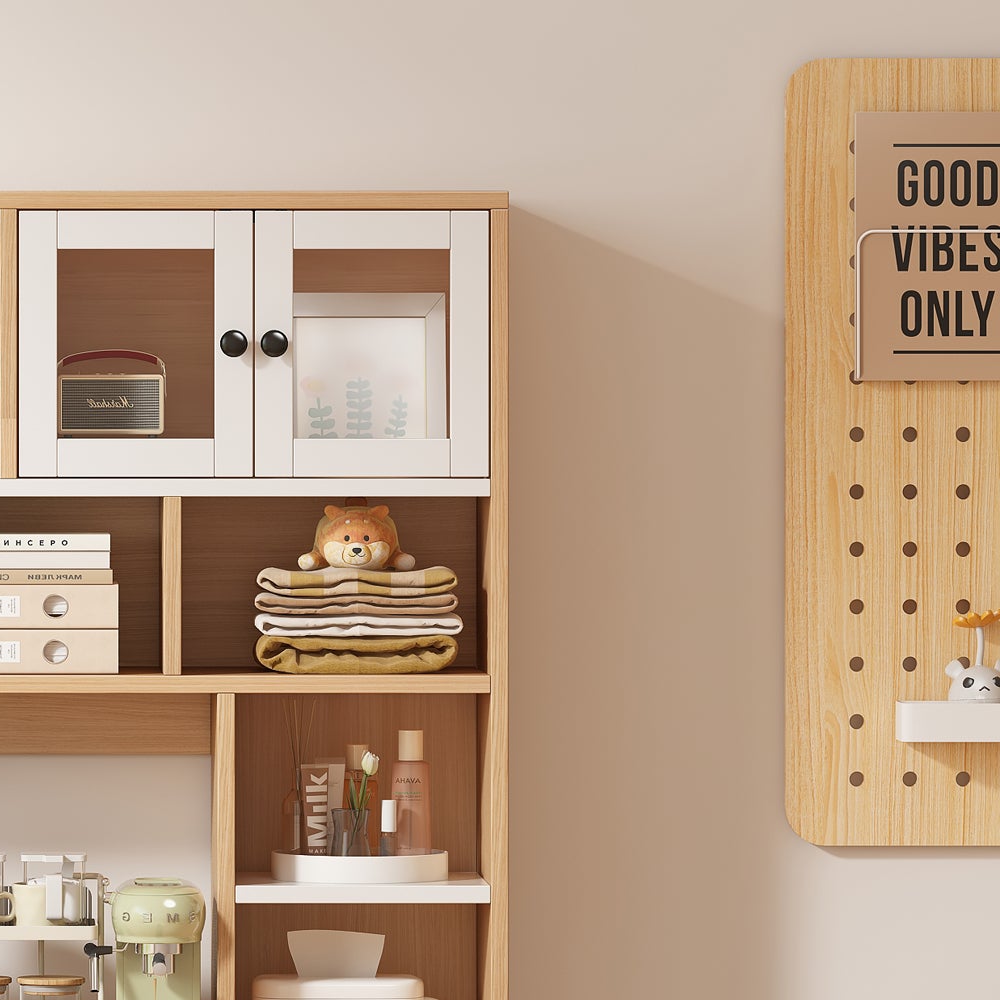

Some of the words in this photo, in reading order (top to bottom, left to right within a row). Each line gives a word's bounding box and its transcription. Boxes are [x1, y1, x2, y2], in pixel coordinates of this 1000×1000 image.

[897, 159, 998, 207] GOOD
[890, 225, 1000, 272] VIBES
[900, 290, 995, 337] ONLY
[305, 772, 328, 847] Milk
